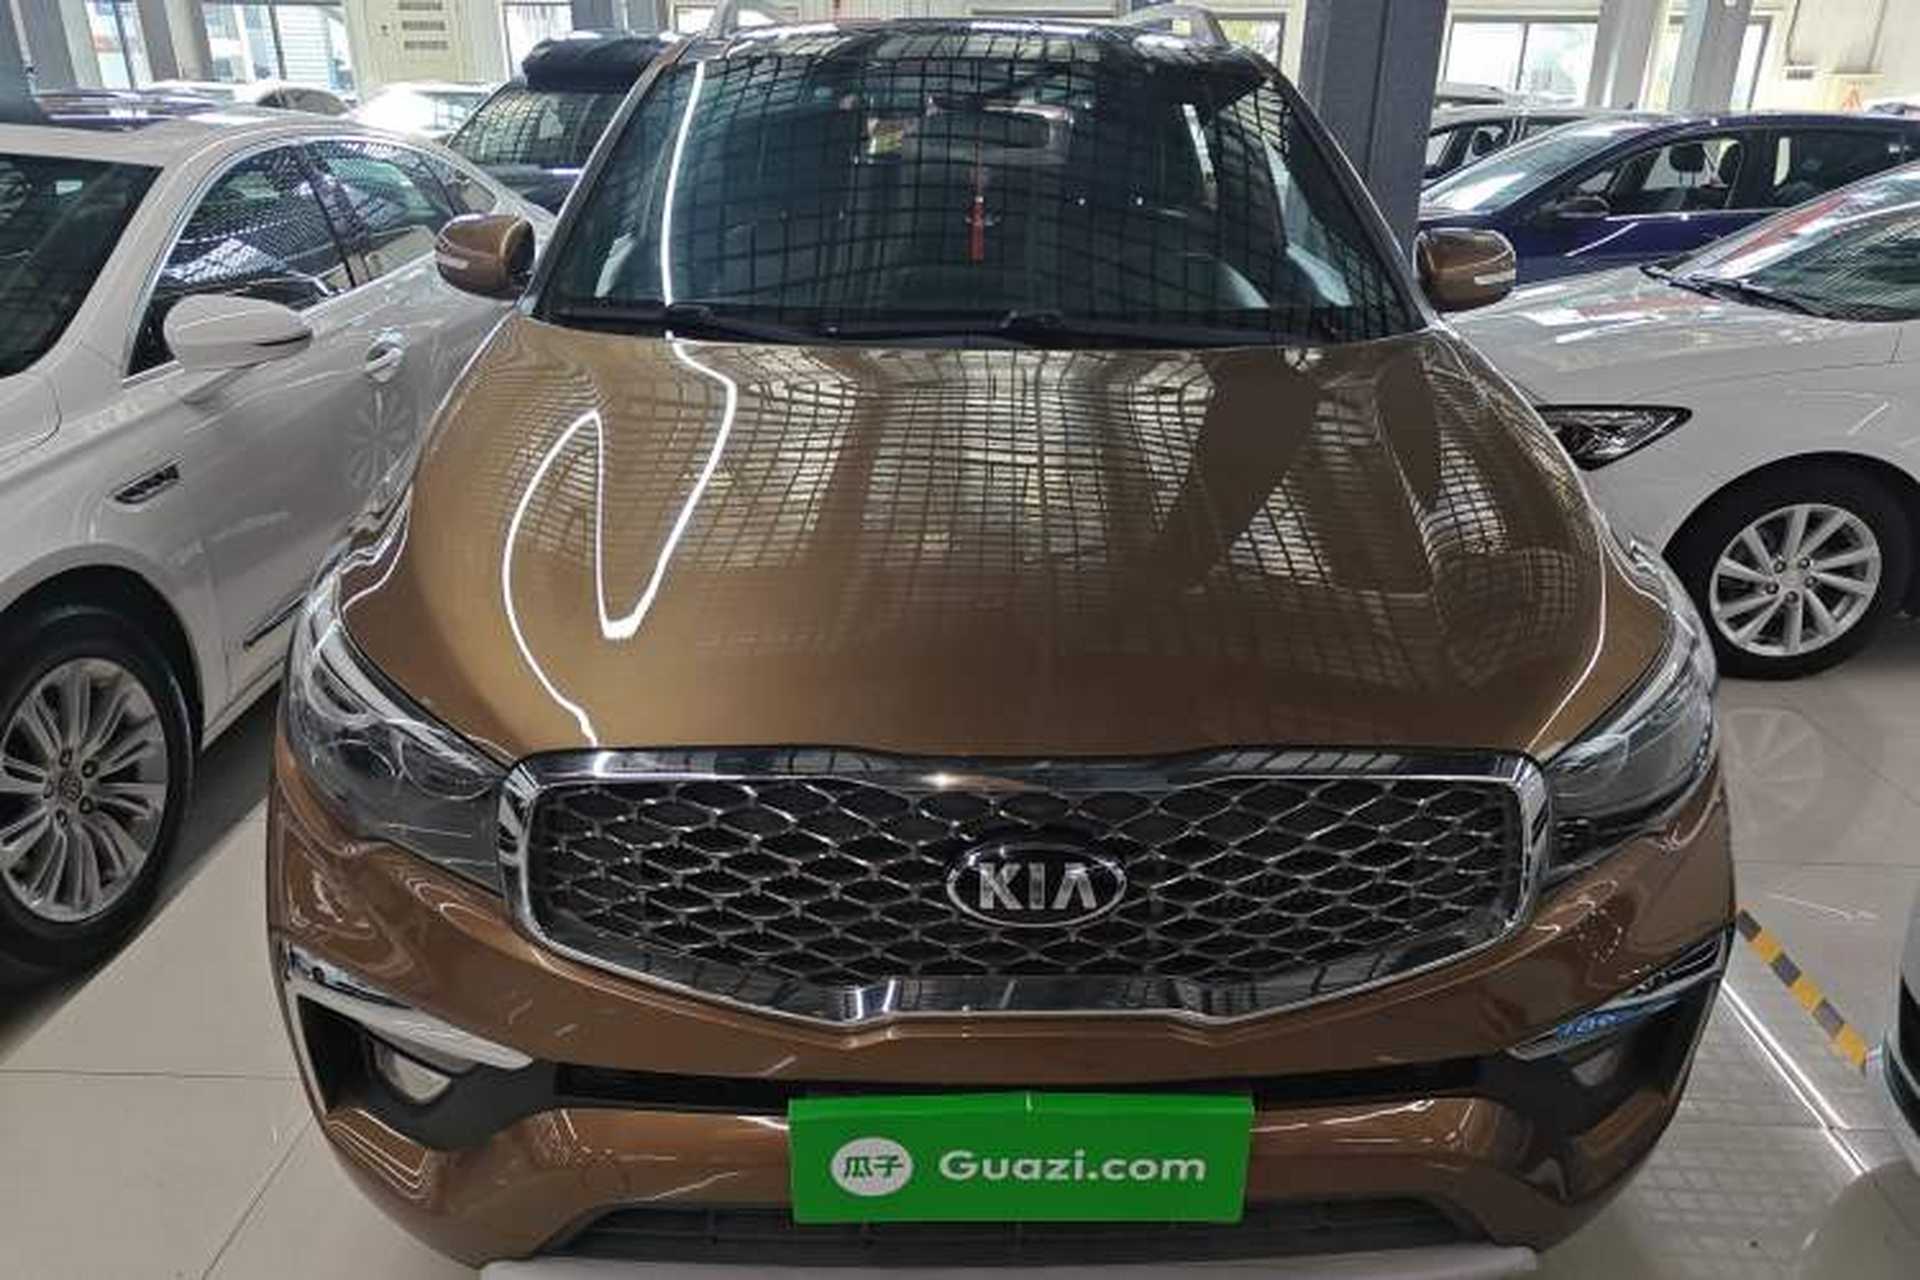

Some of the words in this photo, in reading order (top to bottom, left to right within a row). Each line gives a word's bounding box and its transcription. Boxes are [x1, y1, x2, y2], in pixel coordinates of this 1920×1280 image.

[979, 862, 1098, 910] KIA
[843, 1155, 905, 1179] 瓜子
[939, 1150, 1206, 1181] Guazi.com
